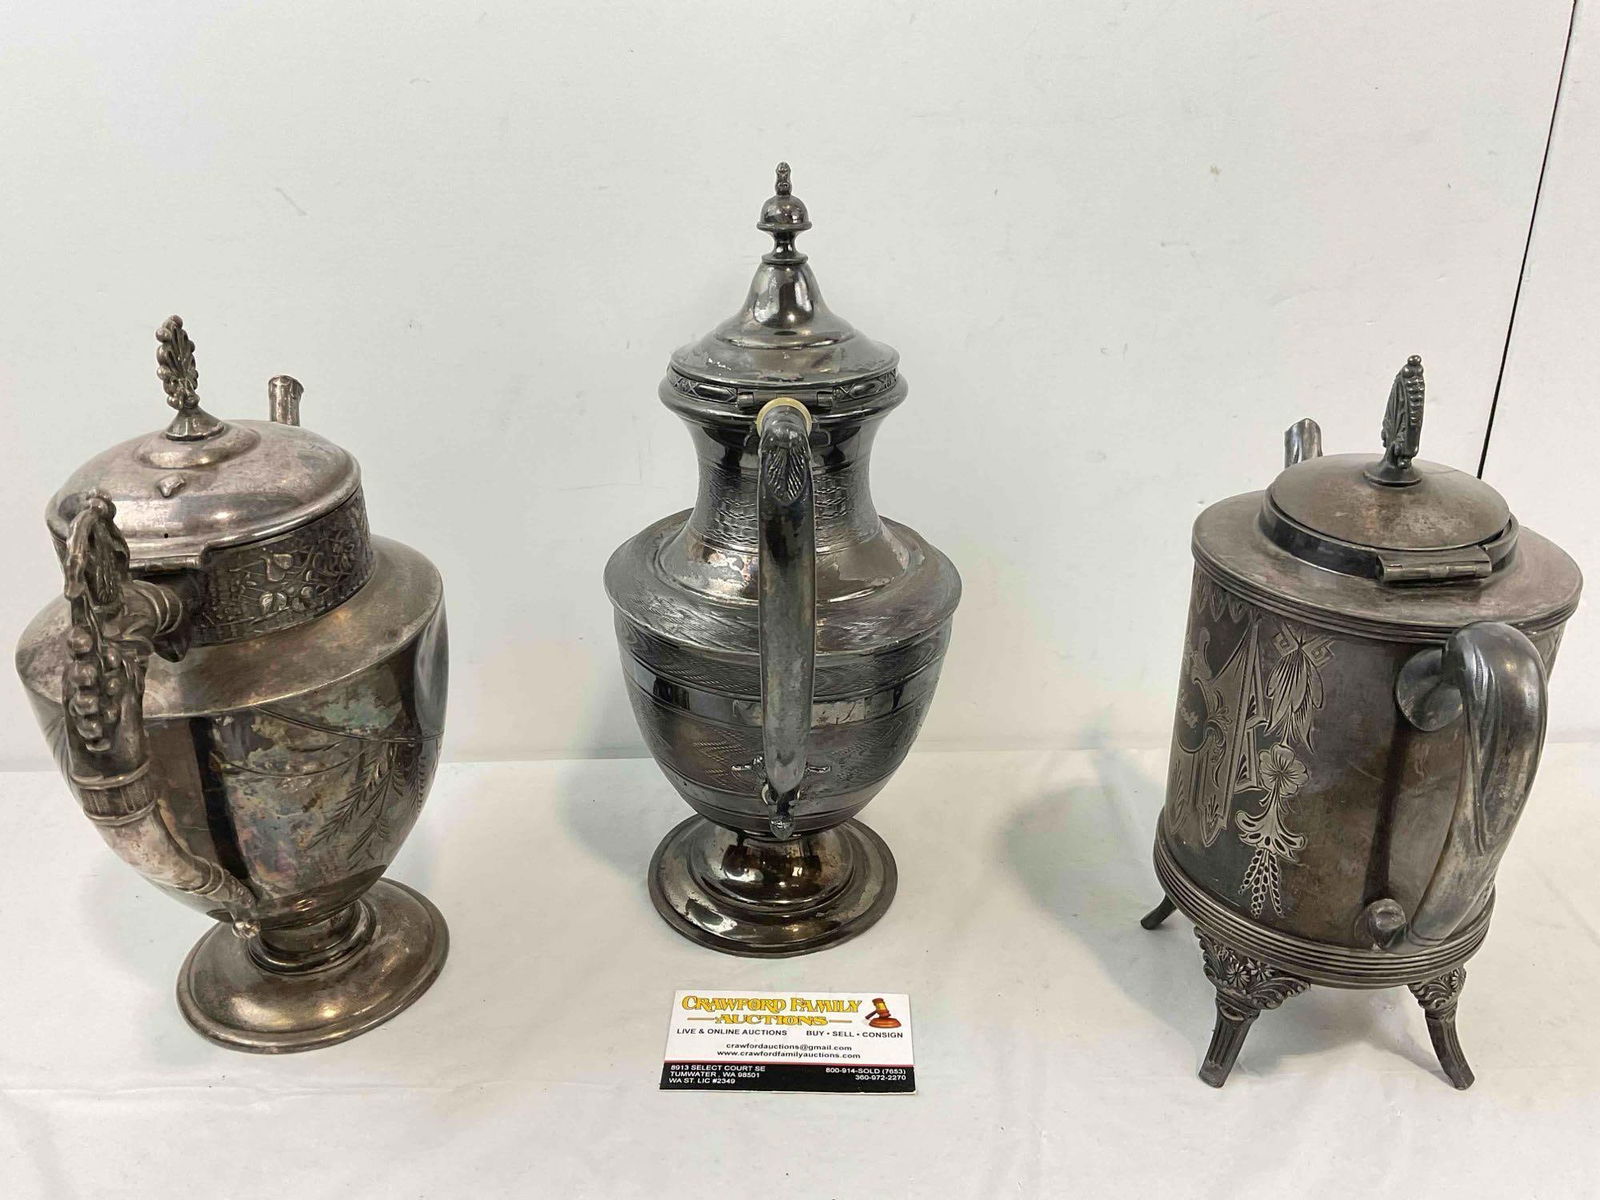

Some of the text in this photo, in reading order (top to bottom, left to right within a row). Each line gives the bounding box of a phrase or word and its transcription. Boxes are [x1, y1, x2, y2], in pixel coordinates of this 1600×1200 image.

[682, 995, 862, 1013] CRAWFORD FAMILY
[715, 1014, 829, 1026] AUCTIONS
[726, 1043, 852, 1051] crawfordauctions@gmail.com
[717, 1050, 861, 1059] www.crawfordfamilyauctions.com
